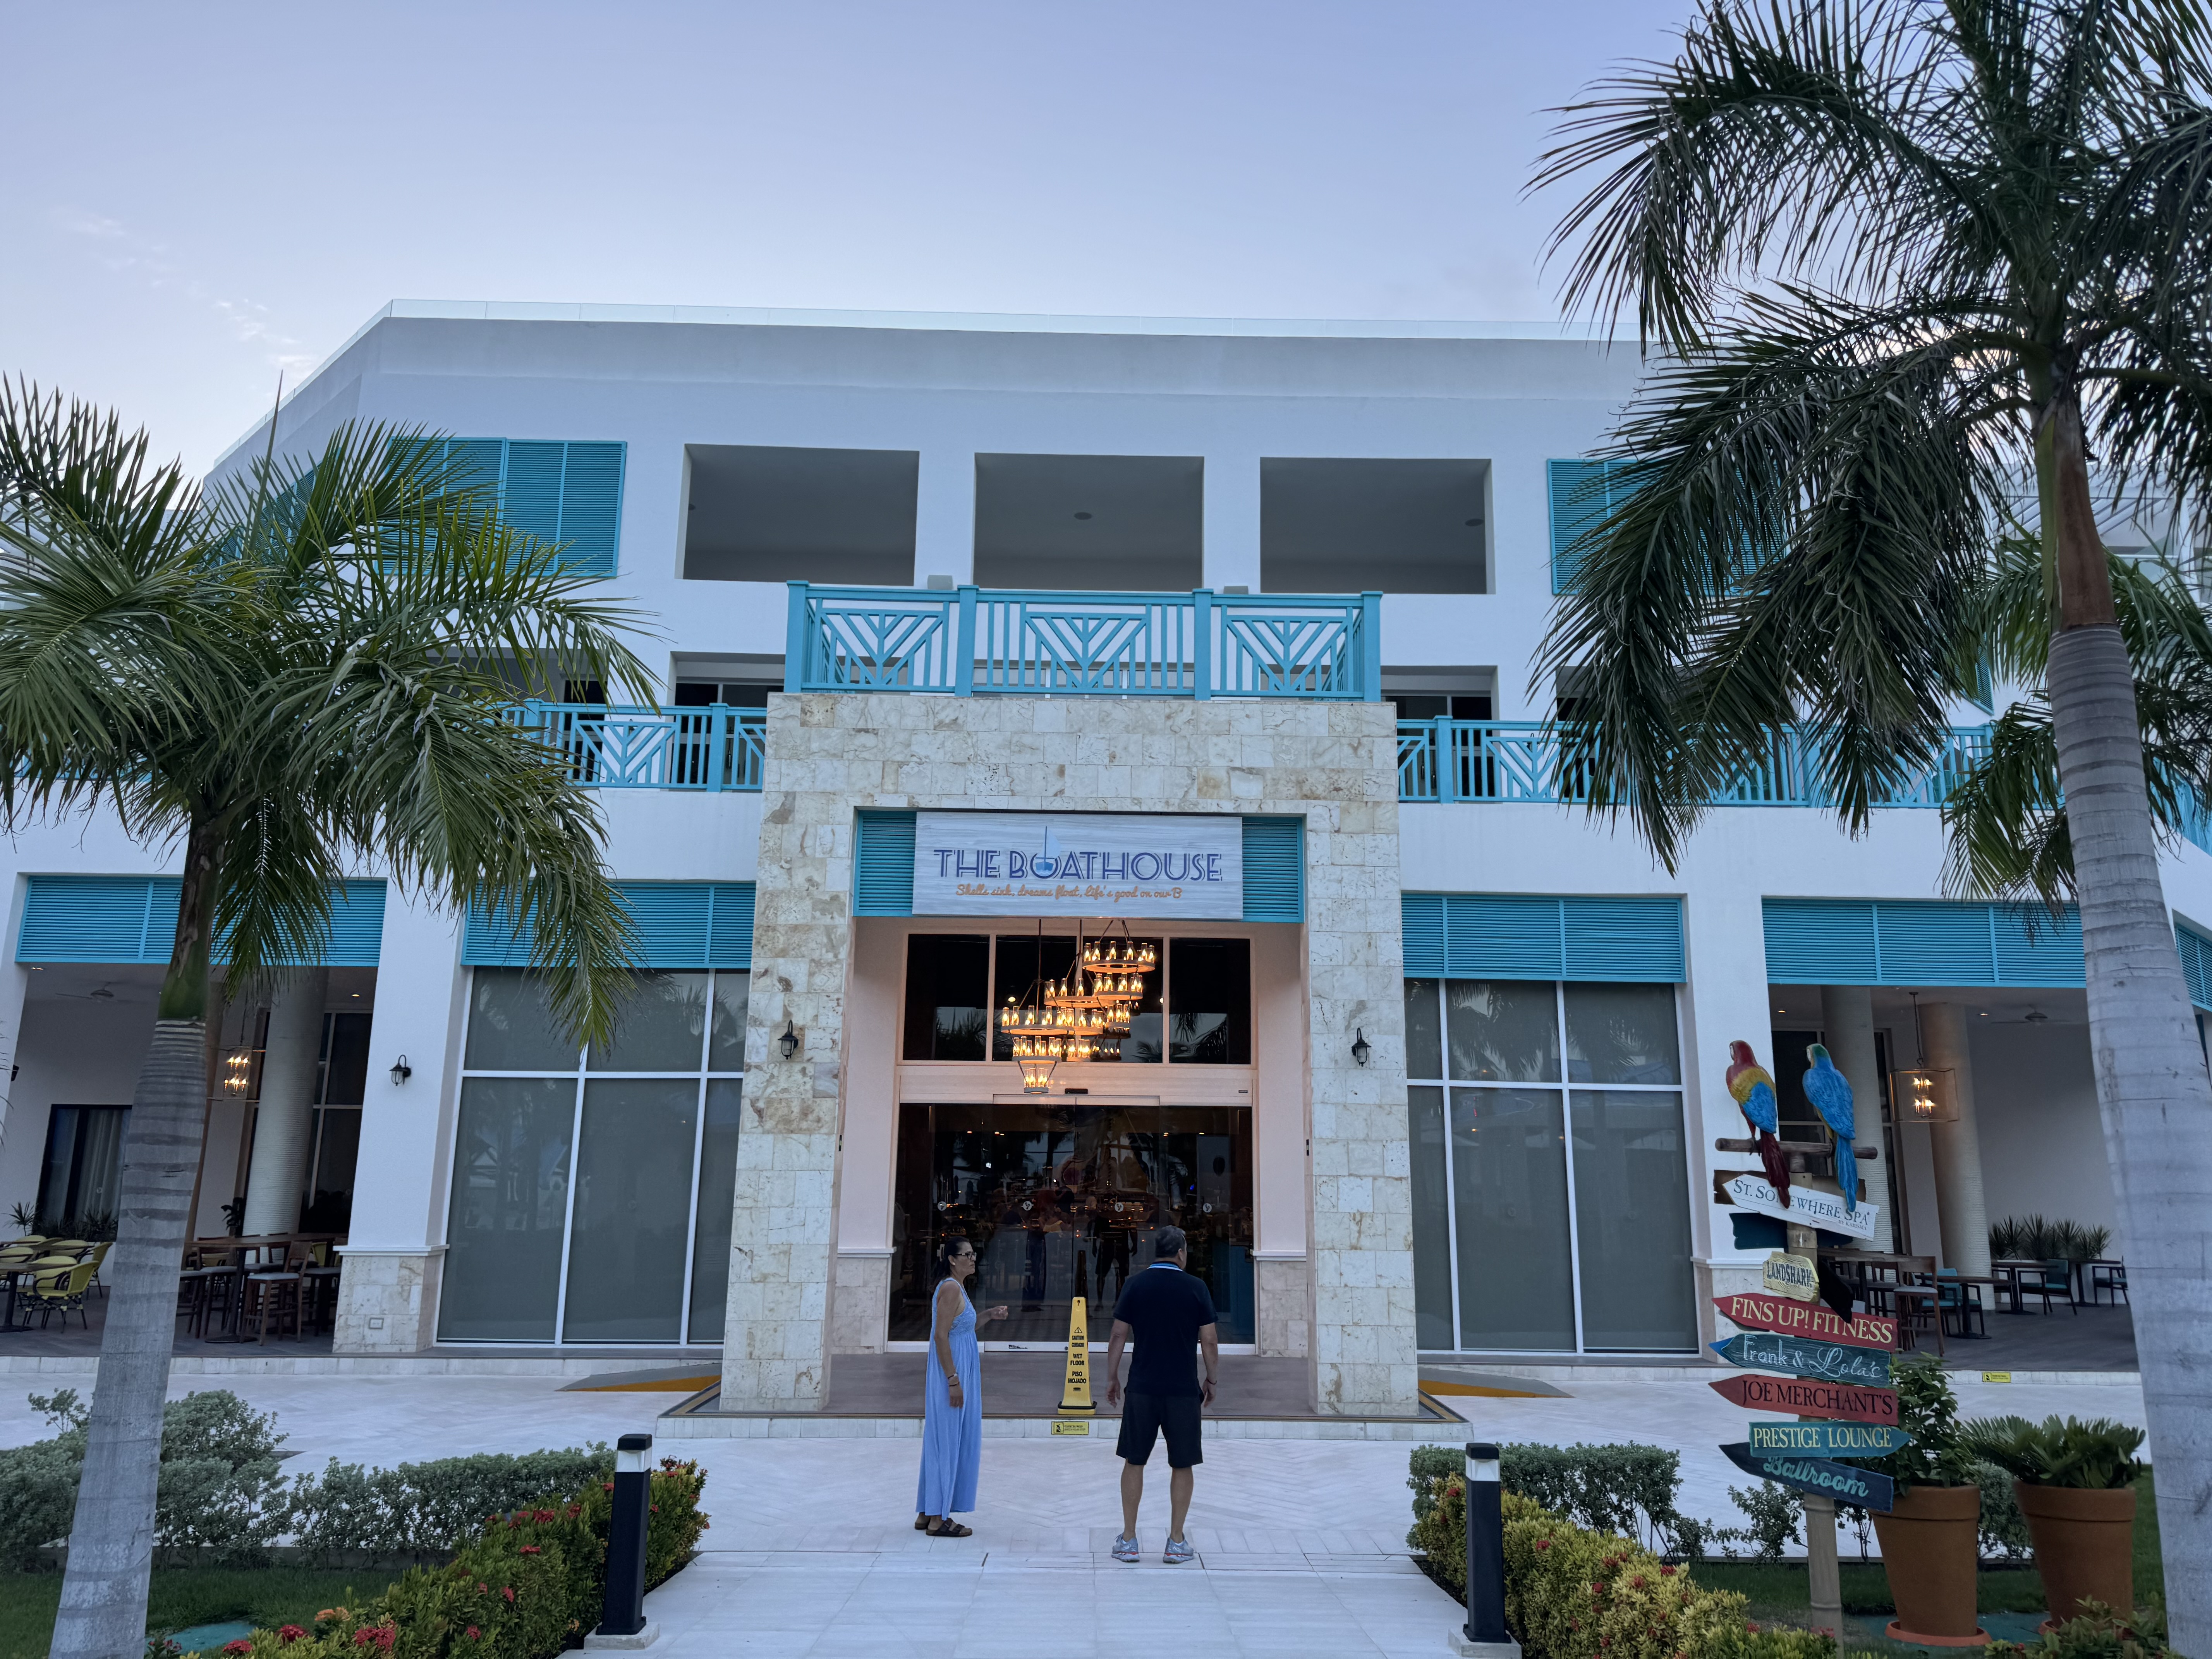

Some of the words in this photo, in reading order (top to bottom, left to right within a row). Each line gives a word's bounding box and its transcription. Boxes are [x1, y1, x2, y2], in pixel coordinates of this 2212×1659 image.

[934, 849, 1000, 878] THE
[1009, 850, 1223, 882] BOATHOUSE
[956, 883, 989, 895] Shells
[991, 884, 1015, 896] sink,
[1018, 884, 1053, 896] dreams
[1055, 884, 1082, 900] float,
[1084, 885, 1113, 900] life's
[1114, 886, 1139, 903] good
[1171, 887, 1183, 898] B
[1733, 1180, 1753, 1196] ST.
[1755, 1185, 1841, 1218] SOEWHERE
[1844, 1208, 1868, 1225] SPA
[1767, 1261, 1812, 1288] LANDSHARK
[1731, 1297, 1774, 1322] FINS
[1779, 1305, 1809, 1329] UP!
[1813, 1311, 1893, 1343] FITNESS
[1743, 1334, 1788, 1367] Frank
[1793, 1350, 1805, 1368] &
[1808, 1347, 1883, 1377] Lola's
[1743, 1380, 1773, 1405] JOE
[1777, 1384, 1893, 1415] MERCHANT'S
[1753, 1427, 1820, 1448] PRESTIGE
[1828, 1427, 1892, 1448] LOUNGE
[1763, 1456, 1869, 1497] Ballroom
